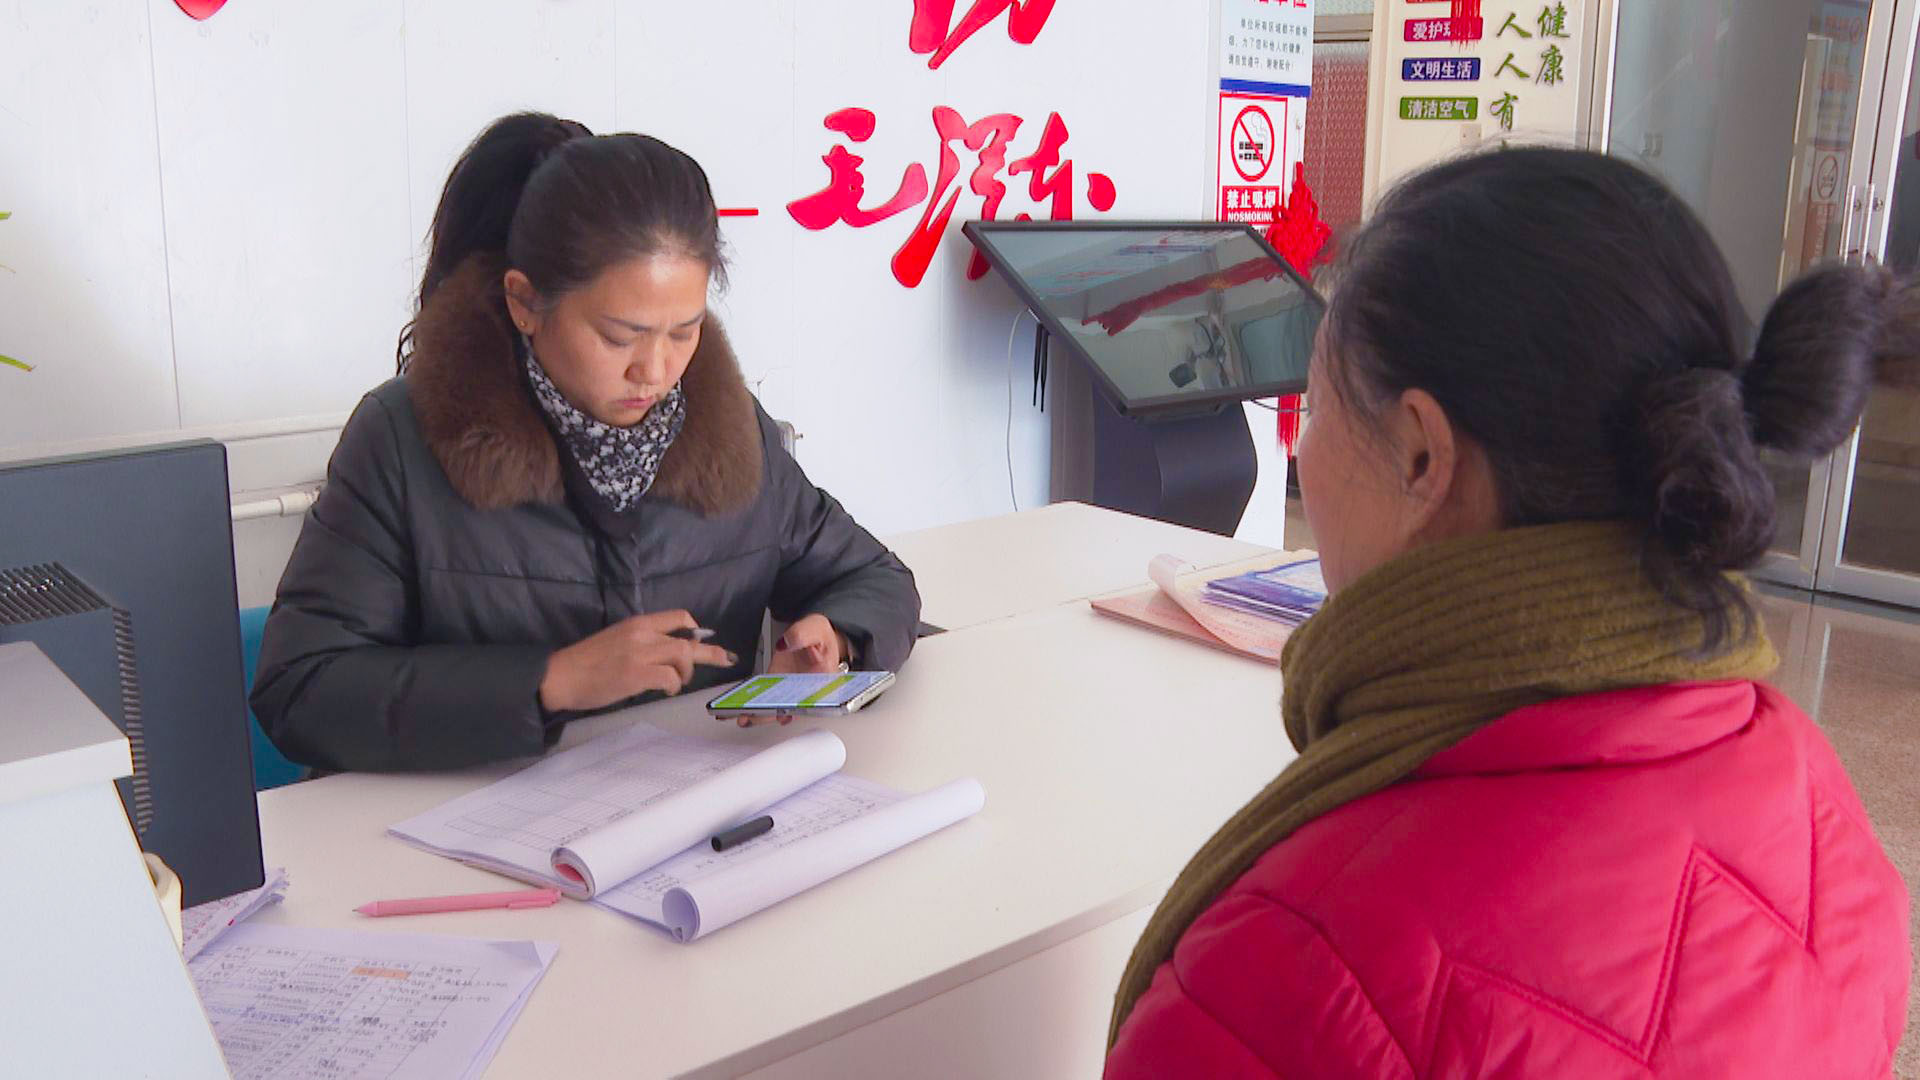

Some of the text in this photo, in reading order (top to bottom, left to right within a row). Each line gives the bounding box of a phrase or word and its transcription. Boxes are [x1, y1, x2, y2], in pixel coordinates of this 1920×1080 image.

[1536, 1, 1571, 86] 健康
[1410, 60, 1472, 79] 文明生活
[1490, 12, 1533, 149] 人人有
[1407, 100, 1470, 118] 清洁空气
[1227, 189, 1276, 208] 禁止吸烟
